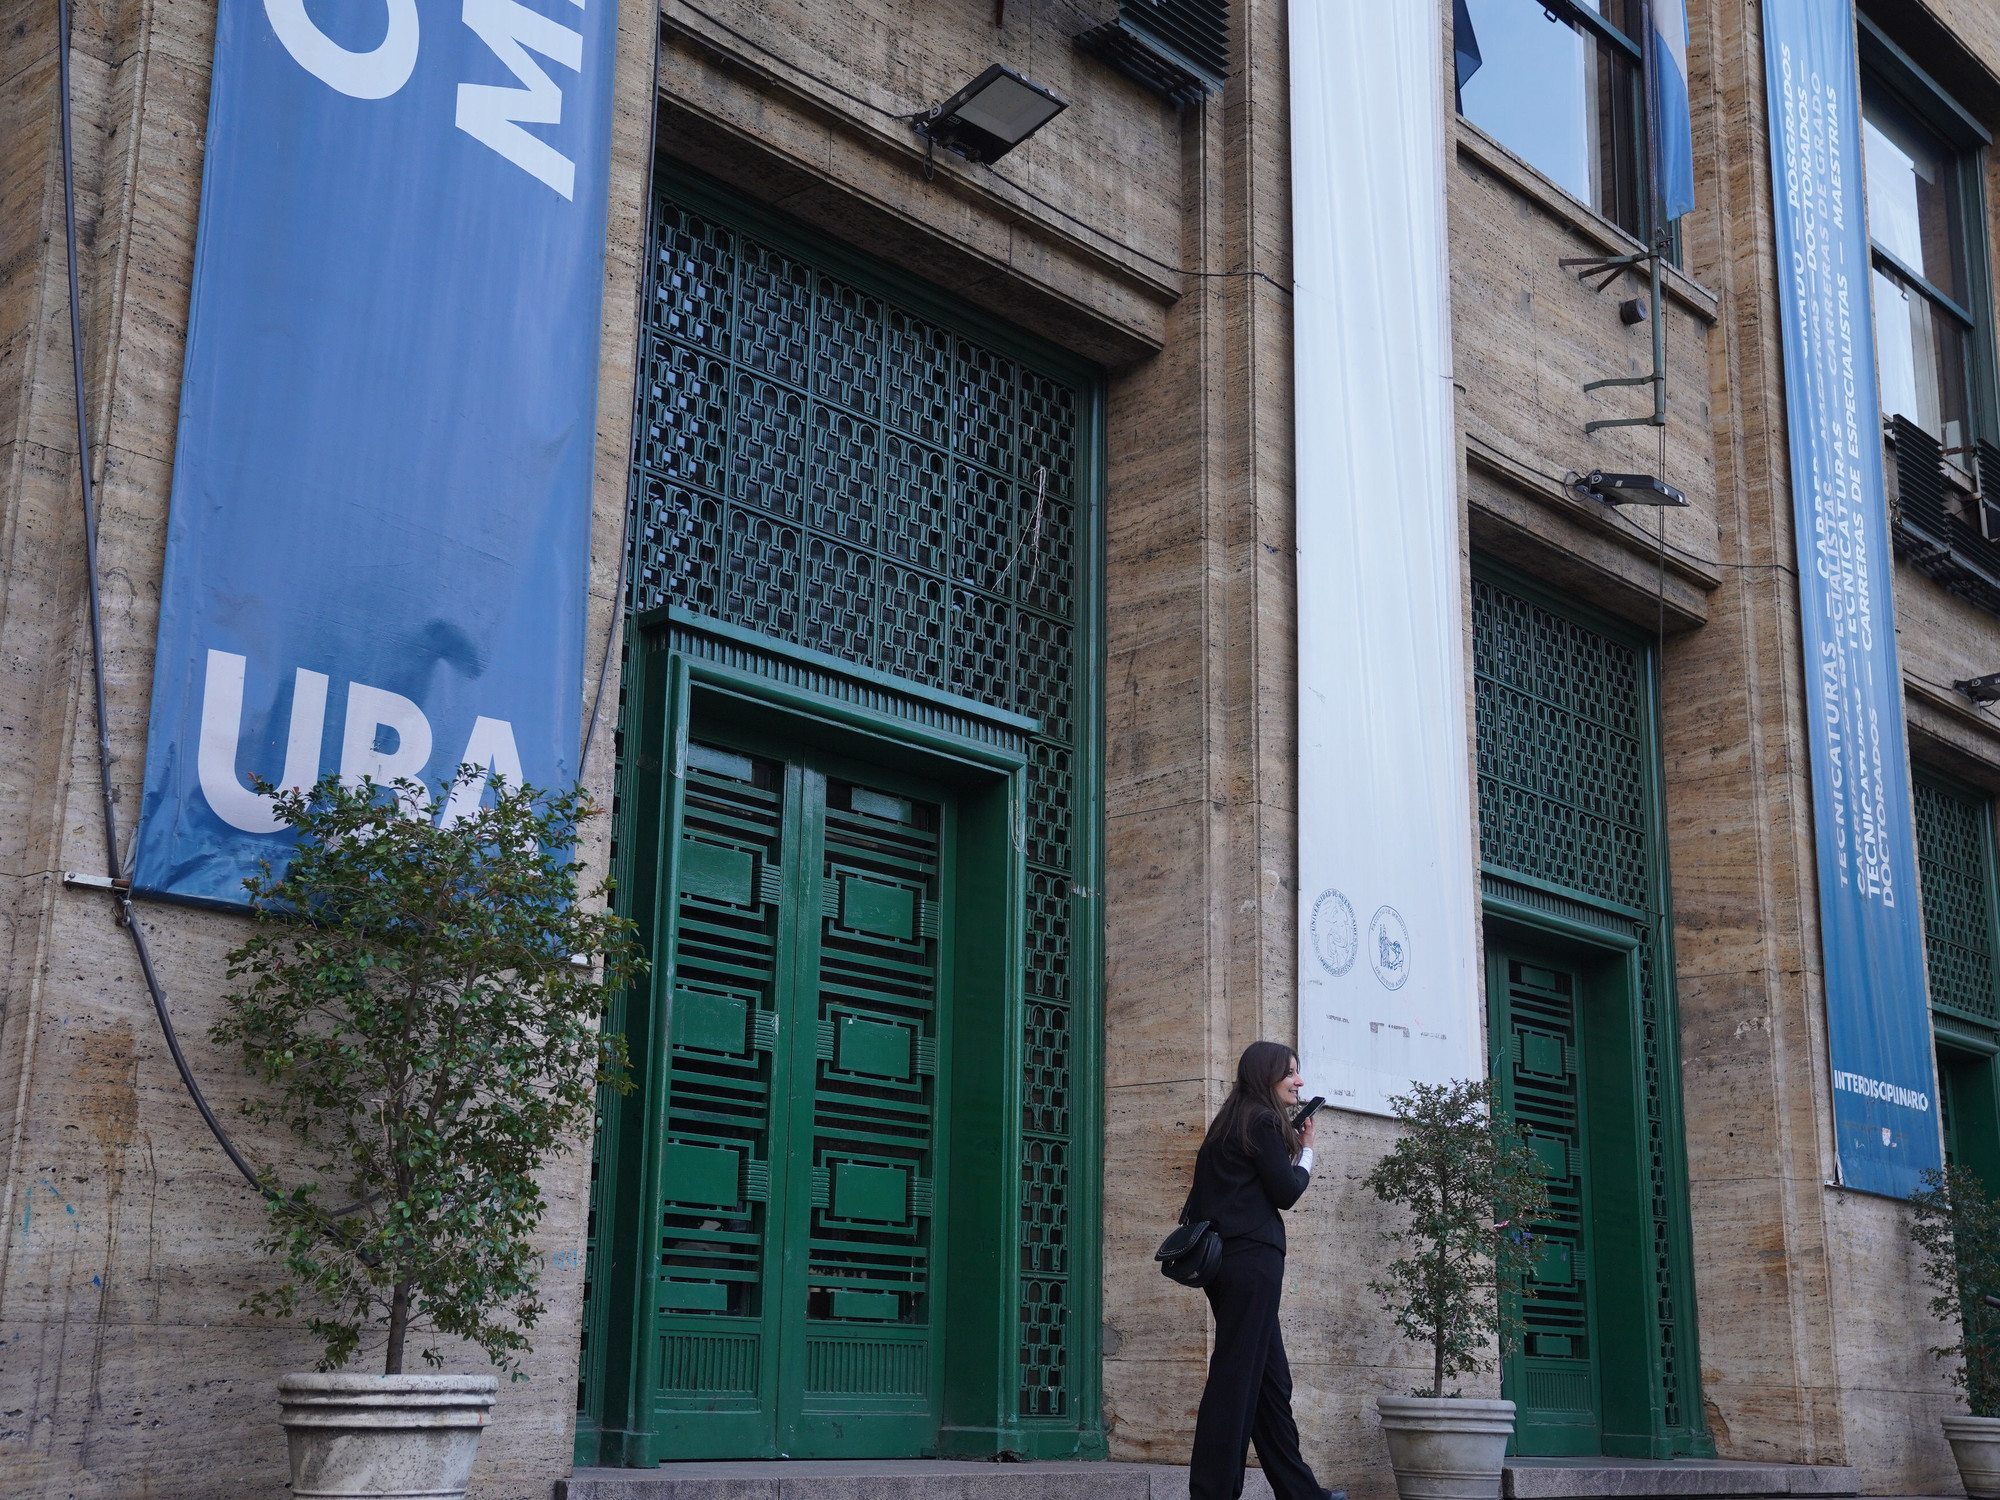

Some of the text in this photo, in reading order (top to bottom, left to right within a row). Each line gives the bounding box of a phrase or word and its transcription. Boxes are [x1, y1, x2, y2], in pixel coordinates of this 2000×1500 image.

[1781, 41, 1801, 210] POSGRADOS
[1798, 86, 1817, 271] DOCTORADOS
[1811, 72, 1826, 175] GRADO
[1816, 180, 1828, 220] DE
[1819, 223, 1837, 376] CARRERAS
[1826, 84, 1895, 908] DOCTORADOS CARRERAS DE ESPECIALISTAS MAESTRIAS
[1832, 421, 1858, 650] TECNICATURAS
[197, 648, 542, 876] UBA
[1821, 641, 1848, 888] TECNICATURAS
[1833, 1069, 1929, 1112] INTERDISCIPLINARIO
